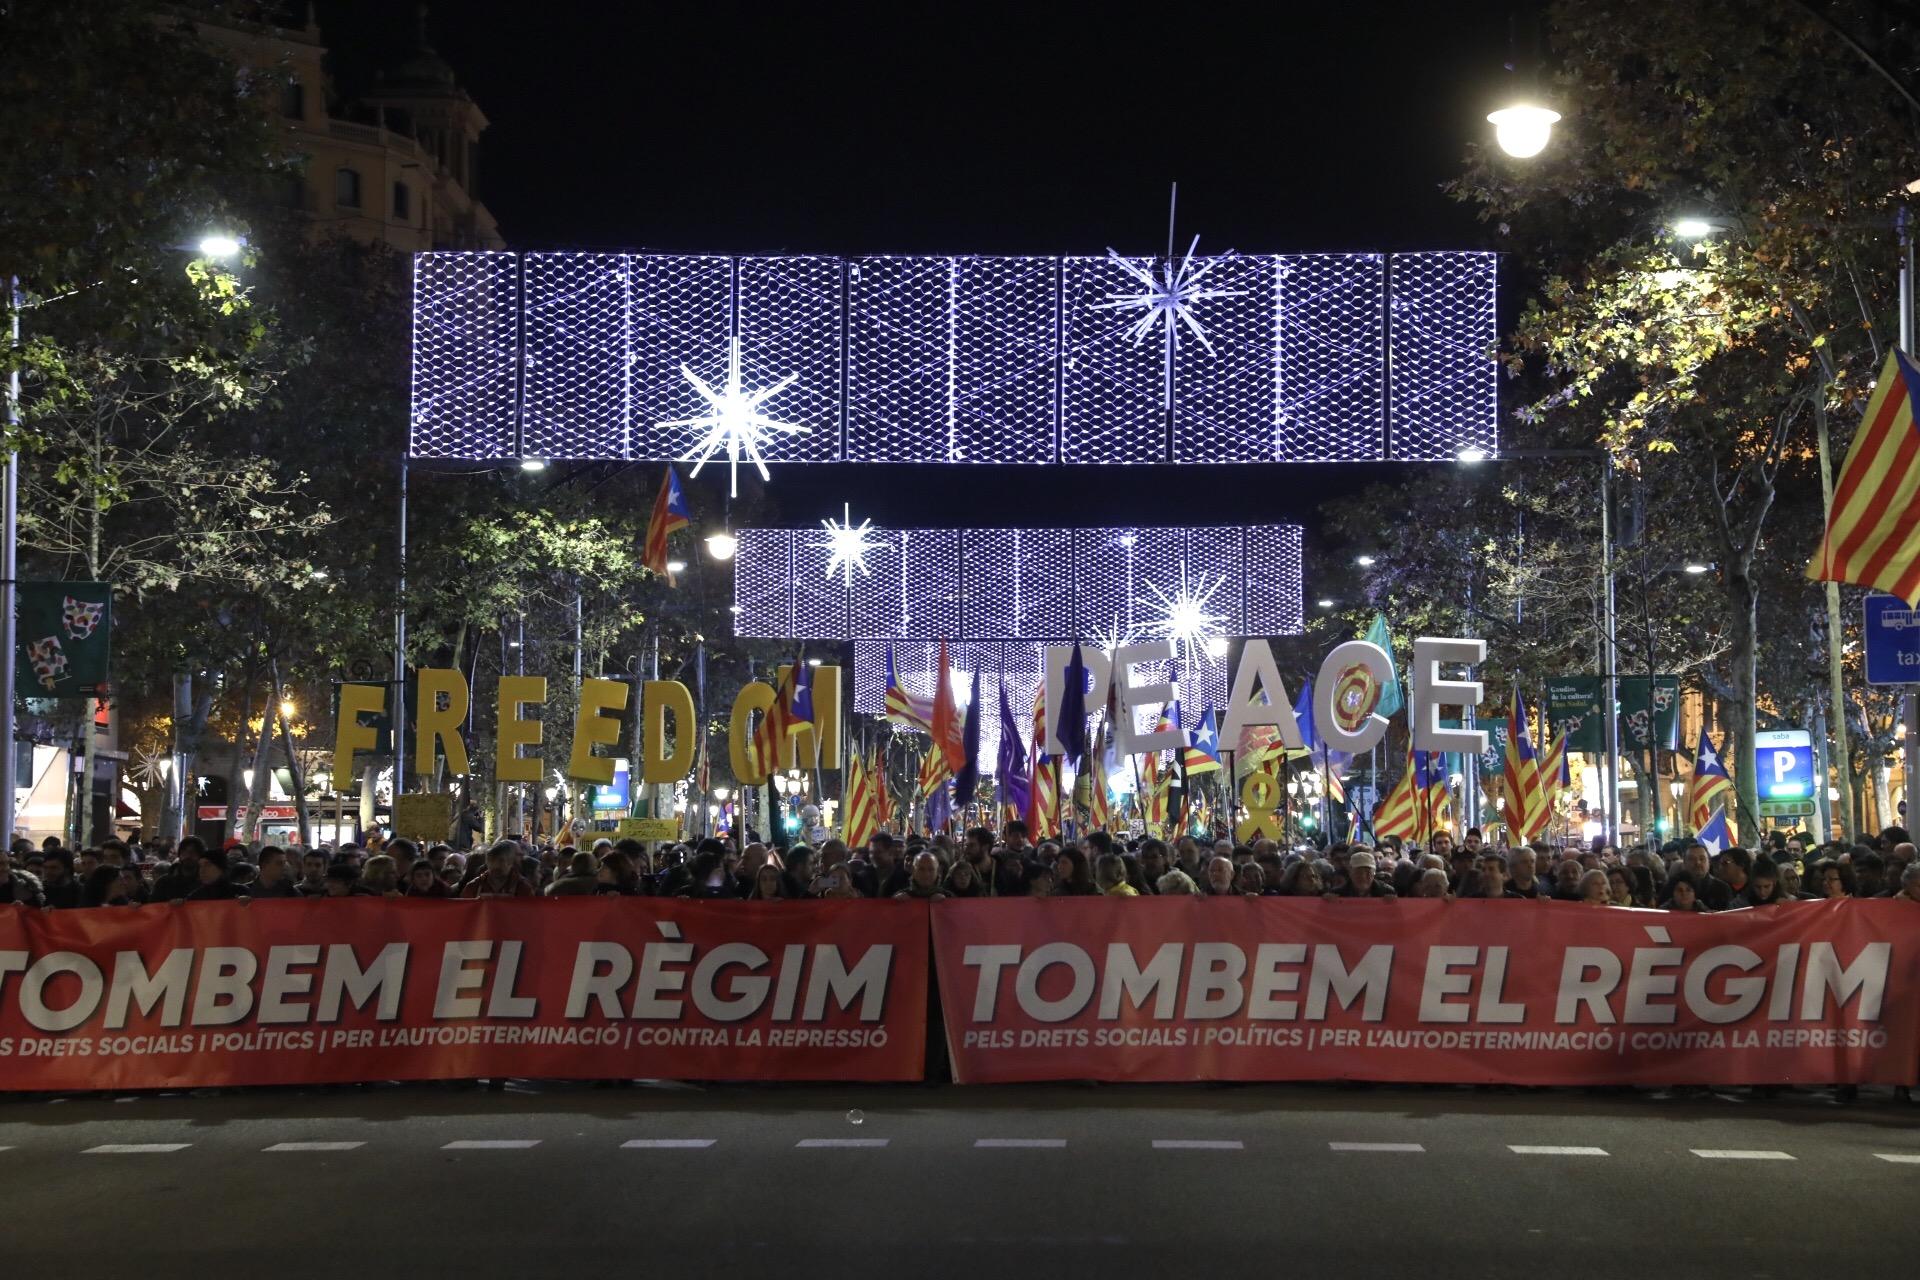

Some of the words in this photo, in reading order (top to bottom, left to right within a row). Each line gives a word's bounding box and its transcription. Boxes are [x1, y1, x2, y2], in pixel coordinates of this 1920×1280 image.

[333, 666, 841, 791] FREEDOM
[1044, 637, 1489, 755] PEACE
[1772, 732, 1790, 740] saba
[1773, 750, 1796, 783] P
[433, 940, 537, 1019] EL
[565, 921, 892, 1021] RÈGIM
[963, 942, 1395, 1023] TOMBEM
[1418, 945, 1526, 1024] EL
[1555, 925, 1892, 1025] RÈGIM
[18, 1037, 94, 1057] DRETS
[97, 1034, 195, 1056] SOCIALS
[211, 1026, 314, 1052] POLÍTICS
[332, 1030, 375, 1048] PER
[637, 1027, 728, 1047] CONTRA
[736, 1028, 762, 1047] LA
[767, 1025, 888, 1048] REPRESSIÓ
[963, 1030, 1014, 1049] PELS
[1019, 1029, 1088, 1048] DRETS
[1094, 1027, 1187, 1047] SOCIALS
[1203, 1023, 1303, 1047] POLÍTICS
[1320, 1029, 1361, 1047] PER
[1631, 1031, 1725, 1050] CONTRA
[1731, 1030, 1761, 1048] LA
[1766, 1025, 1887, 1049] REPRESSIÓ
